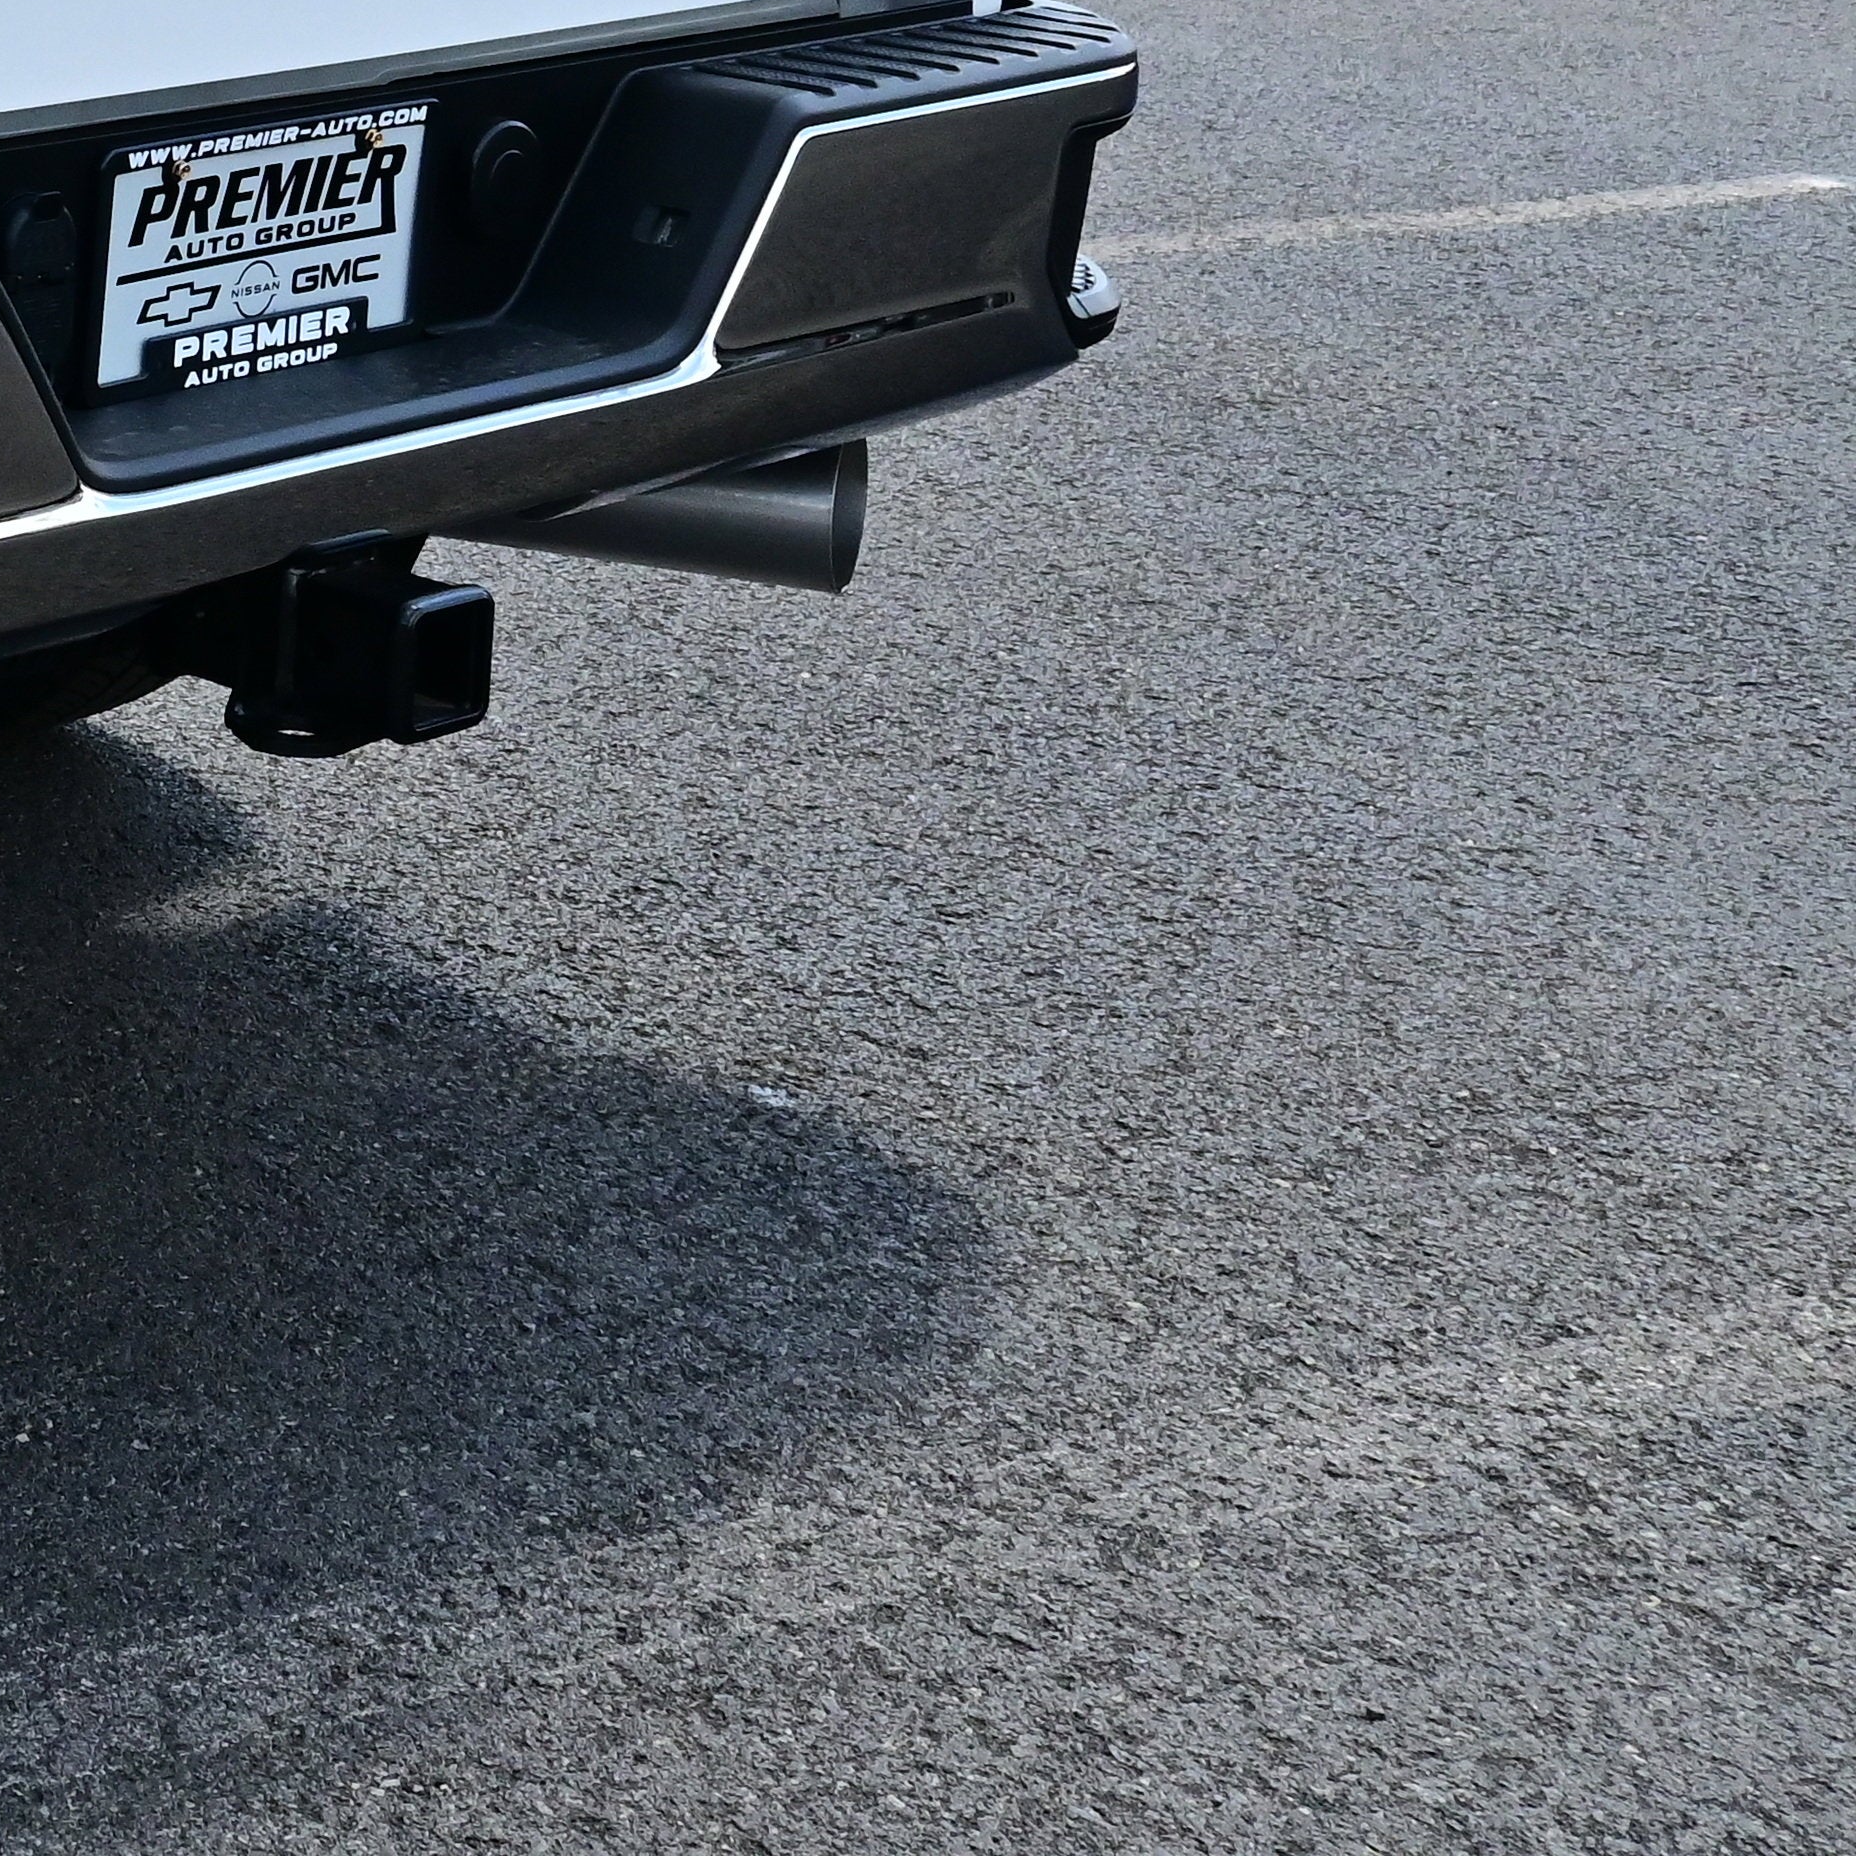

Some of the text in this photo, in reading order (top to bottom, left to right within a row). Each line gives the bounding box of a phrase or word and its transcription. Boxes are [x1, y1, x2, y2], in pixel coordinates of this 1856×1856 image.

[128, 105, 427, 170] WWW.PREMIER-AUTO.COM
[128, 144, 407, 247] PREMIER
[164, 211, 357, 263] AUTO GROUP
[230, 254, 381, 299] NISSAN GMC
[173, 305, 351, 368] PREMIER
[184, 342, 338, 388] AUTO GROUP
